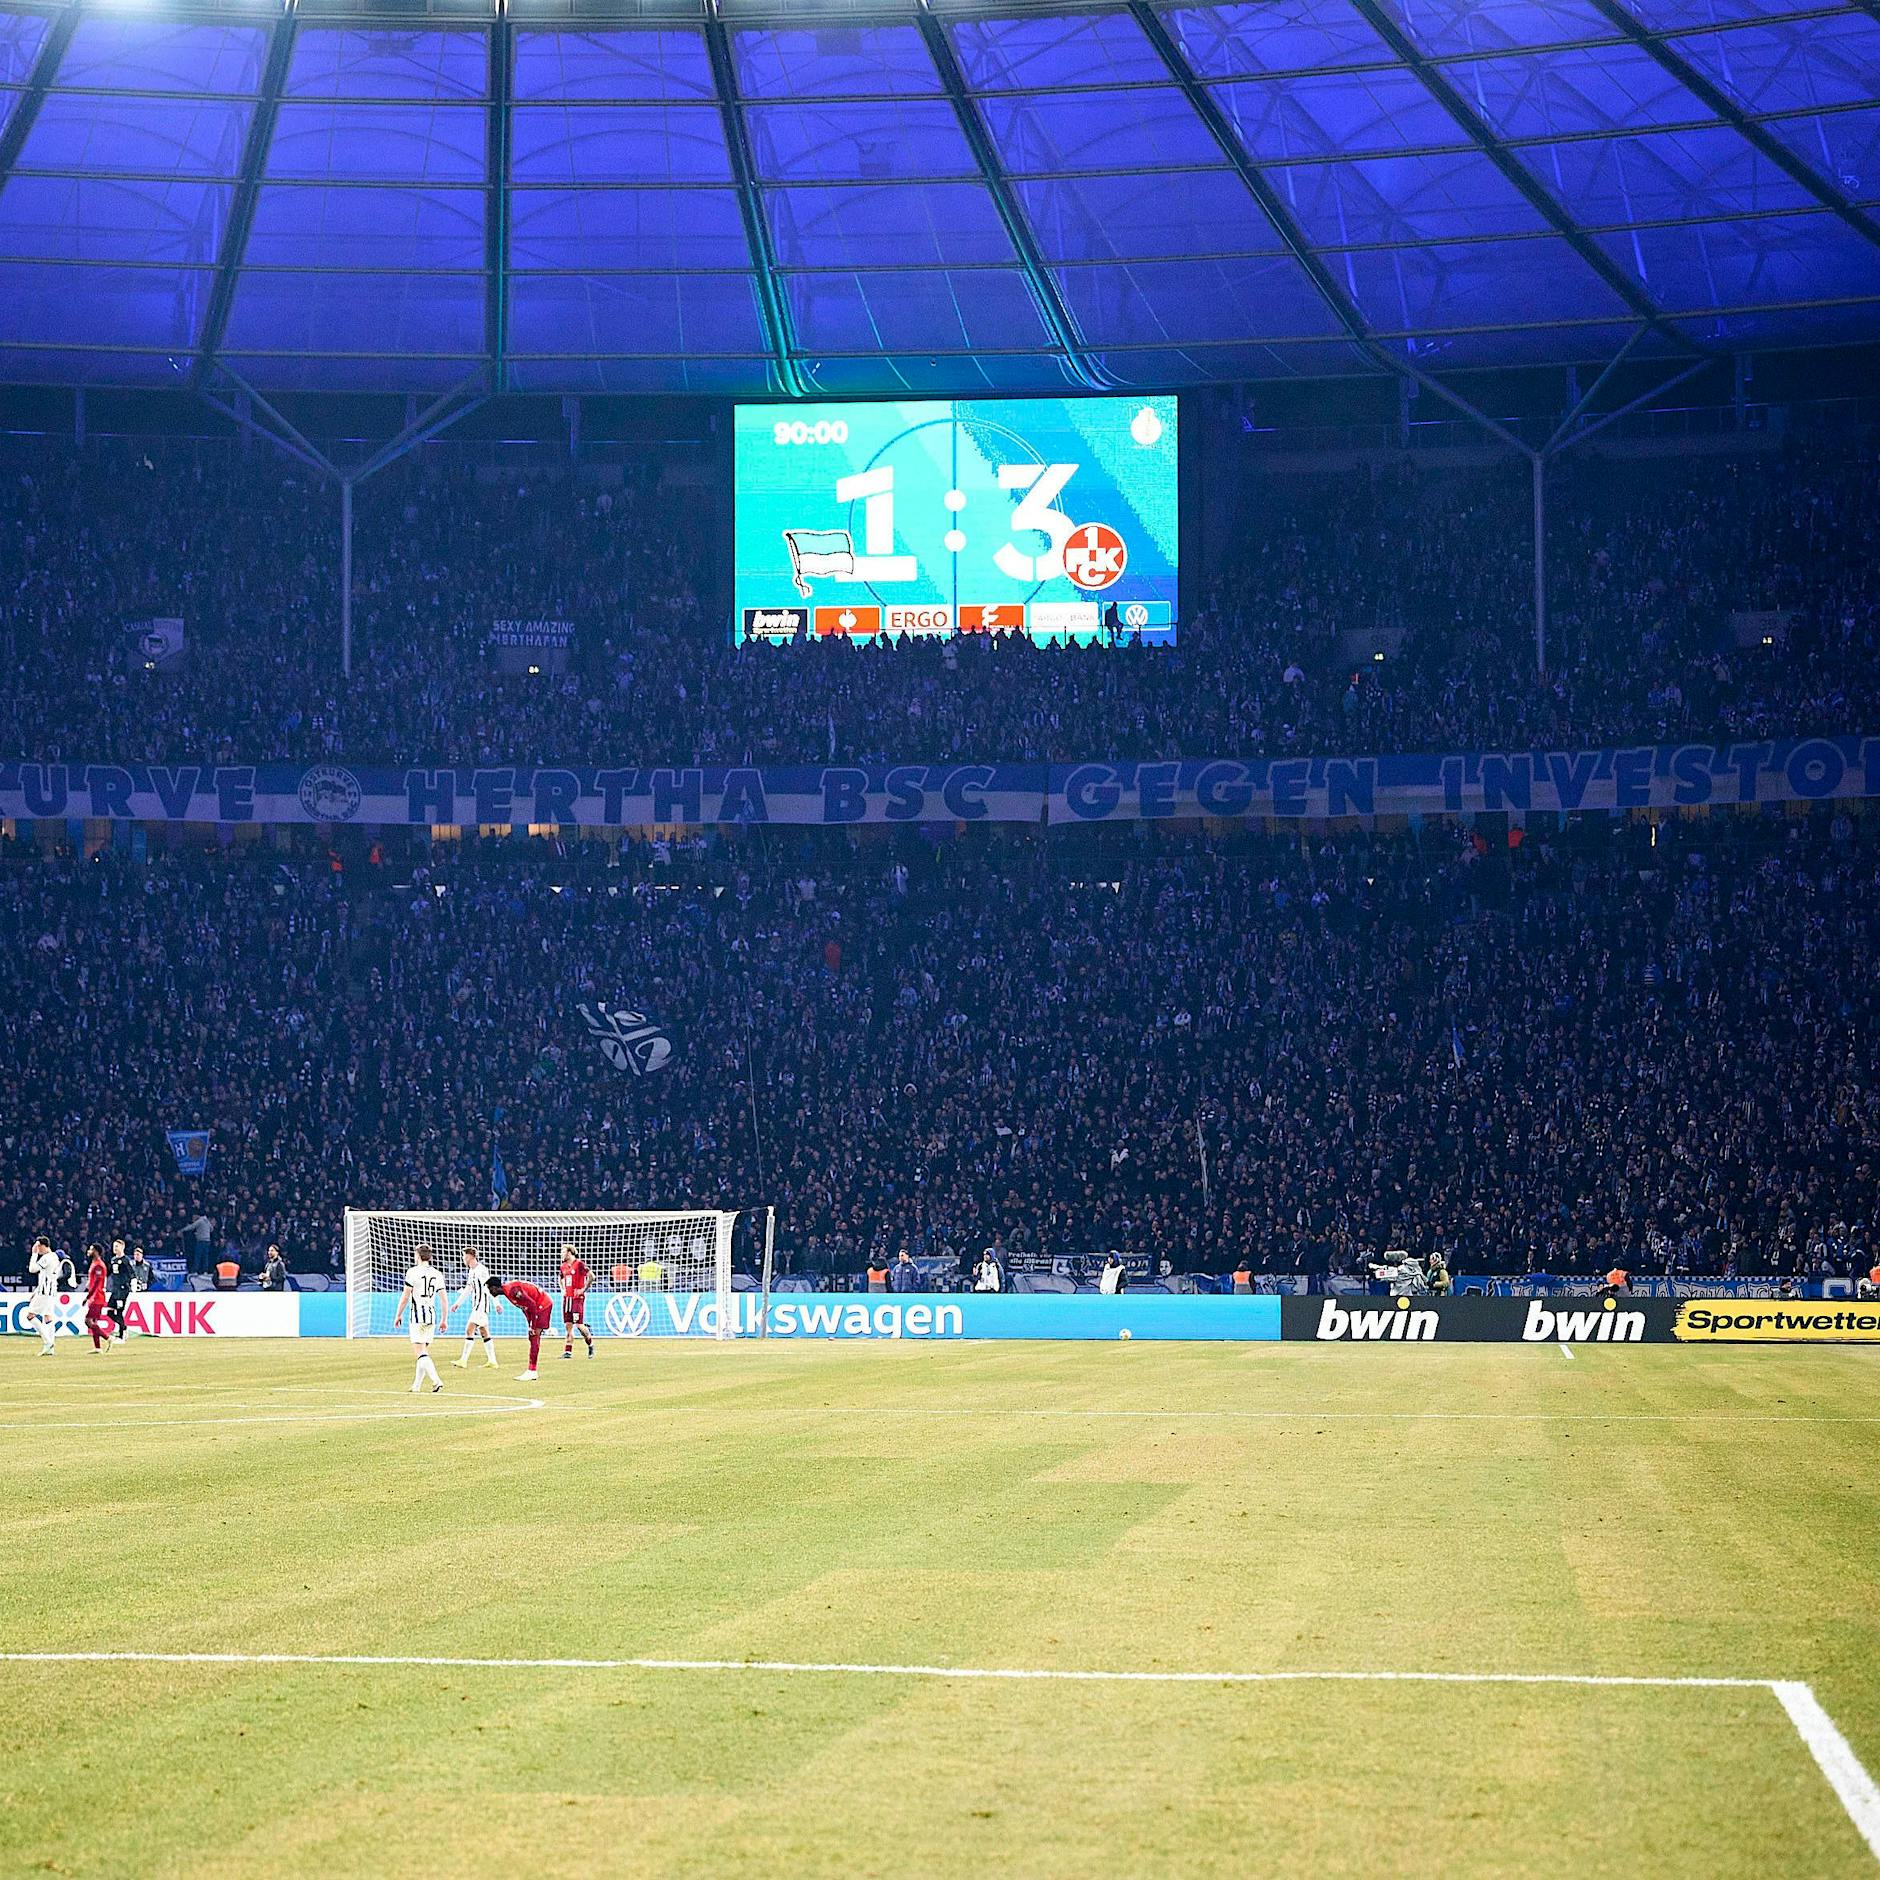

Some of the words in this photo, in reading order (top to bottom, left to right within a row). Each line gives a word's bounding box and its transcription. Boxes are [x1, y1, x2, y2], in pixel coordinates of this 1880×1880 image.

[773, 420, 848, 444] 90:00
[836, 468, 917, 581] 1
[993, 464, 1080, 581] 3
[493, 620, 521, 632] SEXY
[525, 621, 575, 633] AMAZING
[752, 609, 800, 628] bwin
[892, 611, 947, 628] ERGO
[0, 763, 257, 818] URVE
[404, 767, 769, 824] HERTHA
[819, 765, 996, 823] BSC
[1064, 757, 1378, 819] GEGEN
[421, 1275, 436, 1298] 16
[664, 1294, 963, 1337] Volkswagen
[1316, 1297, 1440, 1341] bwin
[1521, 1297, 1646, 1341] bwin
[1687, 1310, 1880, 1334] Sportwette
